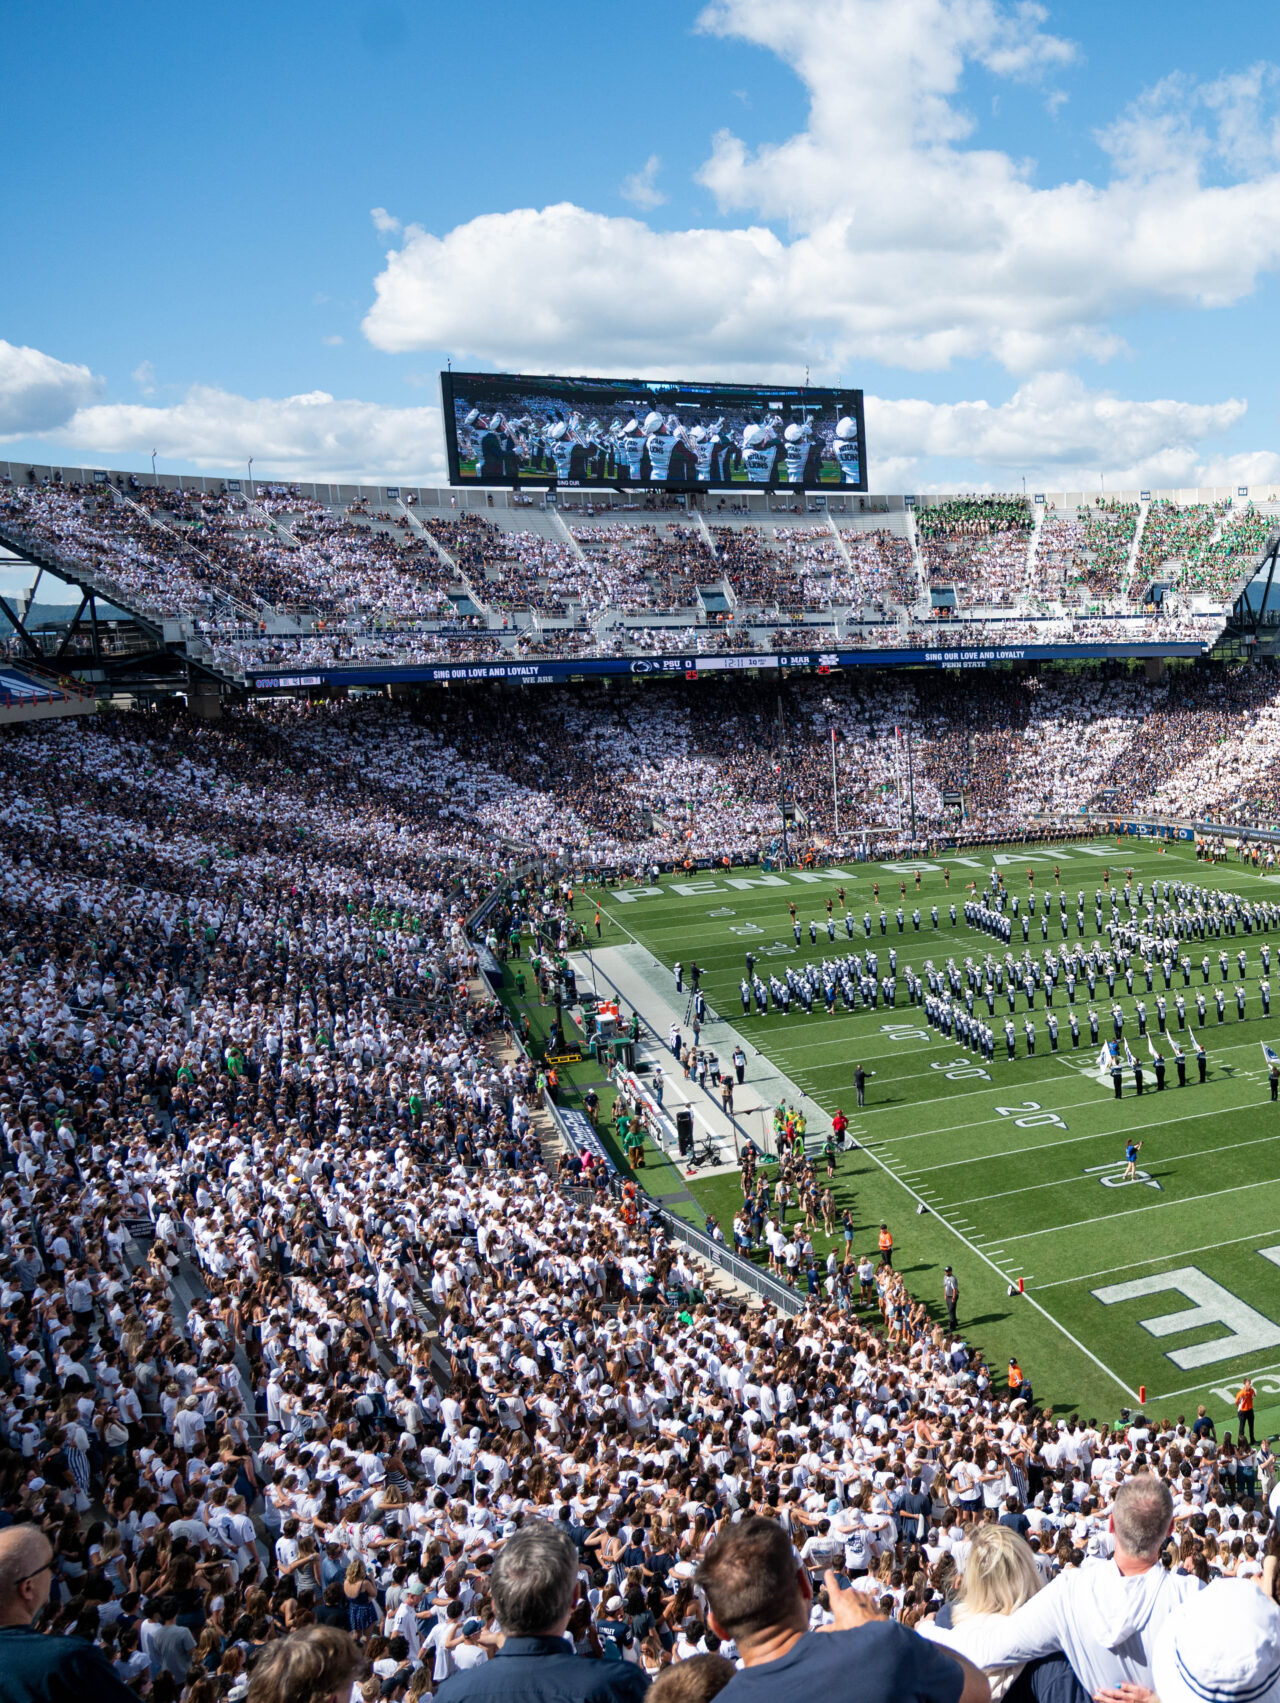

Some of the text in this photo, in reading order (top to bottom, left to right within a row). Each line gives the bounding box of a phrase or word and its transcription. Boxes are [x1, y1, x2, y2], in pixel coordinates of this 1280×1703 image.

[790, 656, 810, 664] MAR
[925, 650, 1025, 661] SING OUR LOVE AND LOYALTY
[663, 660, 692, 668] PSU 0
[818, 665, 830, 674] 25
[433, 666, 539, 679] SING OUR LOVE AND LOYALTY
[686, 670, 698, 679] 25
[610, 845, 1136, 904] PENN STATE
[879, 1023, 928, 1041] 40
[929, 1058, 987, 1081] 30
[993, 1101, 1062, 1129] 20
[1082, 1160, 1152, 1188] 10
